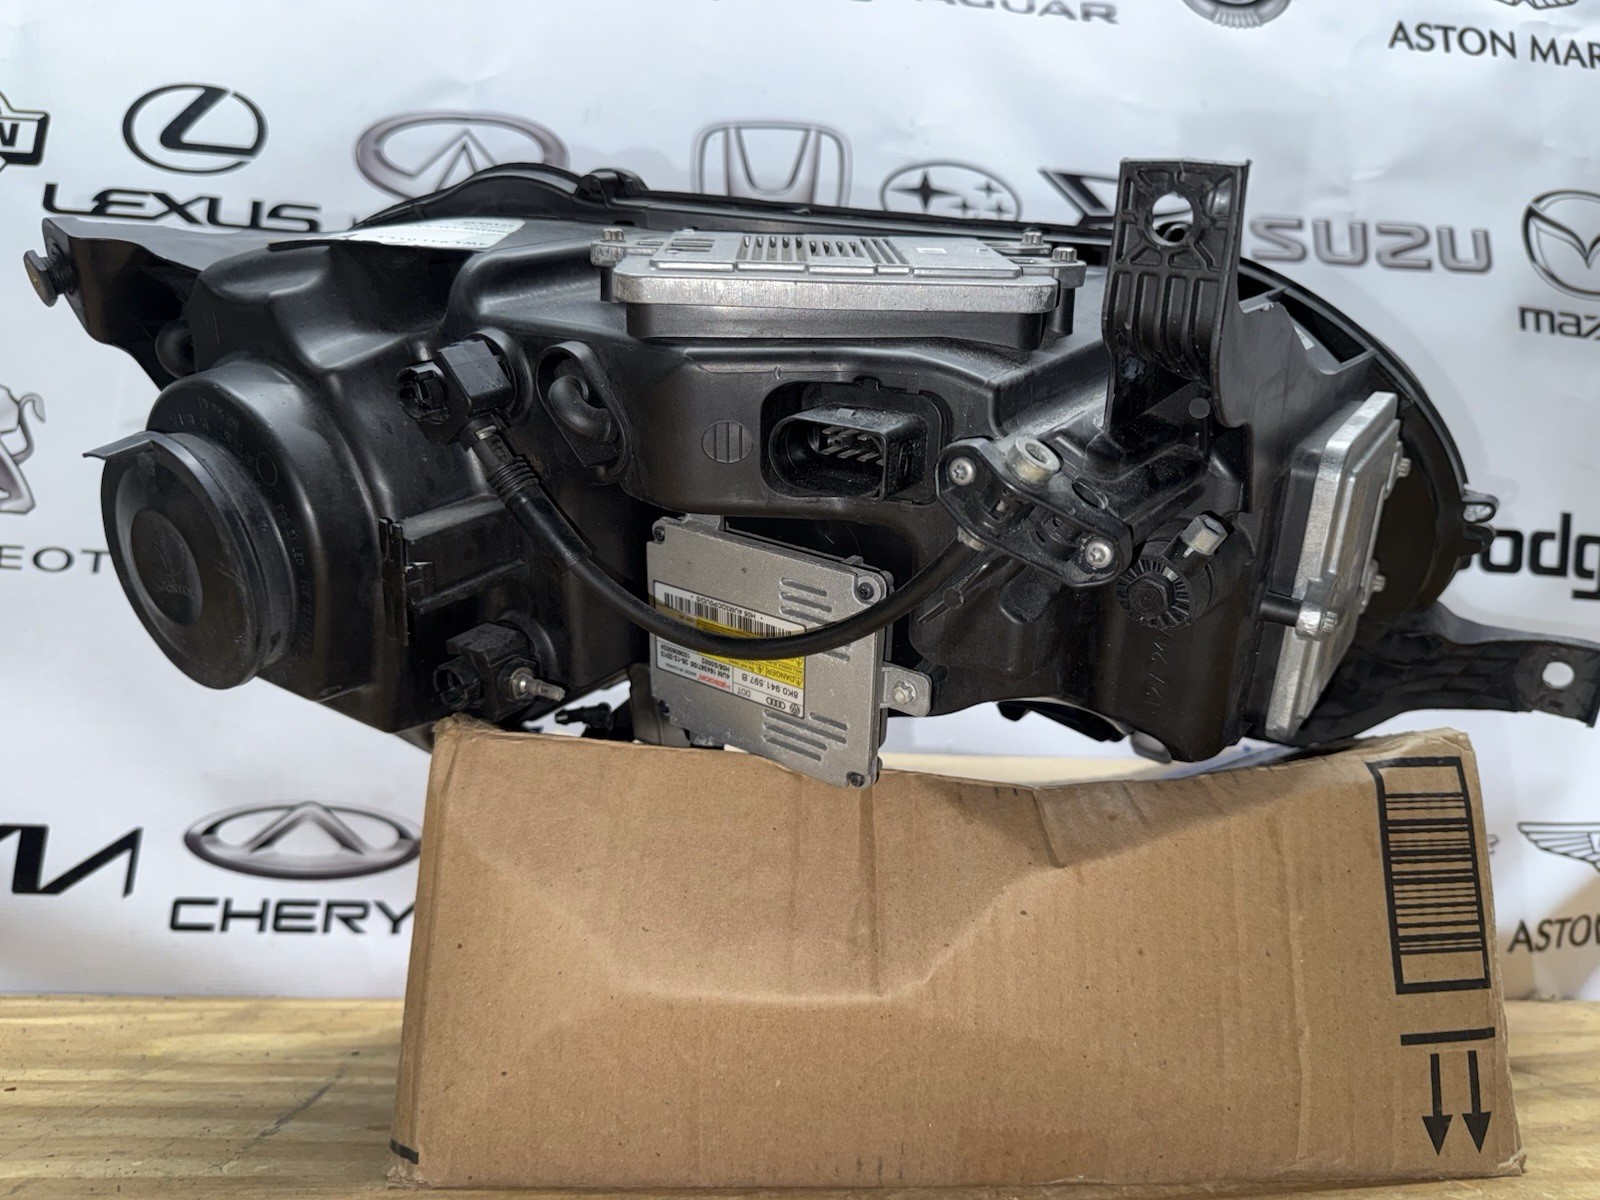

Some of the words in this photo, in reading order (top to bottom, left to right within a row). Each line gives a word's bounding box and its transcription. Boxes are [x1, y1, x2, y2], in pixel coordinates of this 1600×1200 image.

[1389, 21, 1517, 58] ASTON
[43, 183, 321, 232] LEXUS
[1250, 212, 1493, 273] SUZU
[1461, 512, 1600, 600] odg
[737, 687, 751, 698] DOT
[767, 668, 795, 683] DANGER
[170, 896, 416, 934] CHERY
